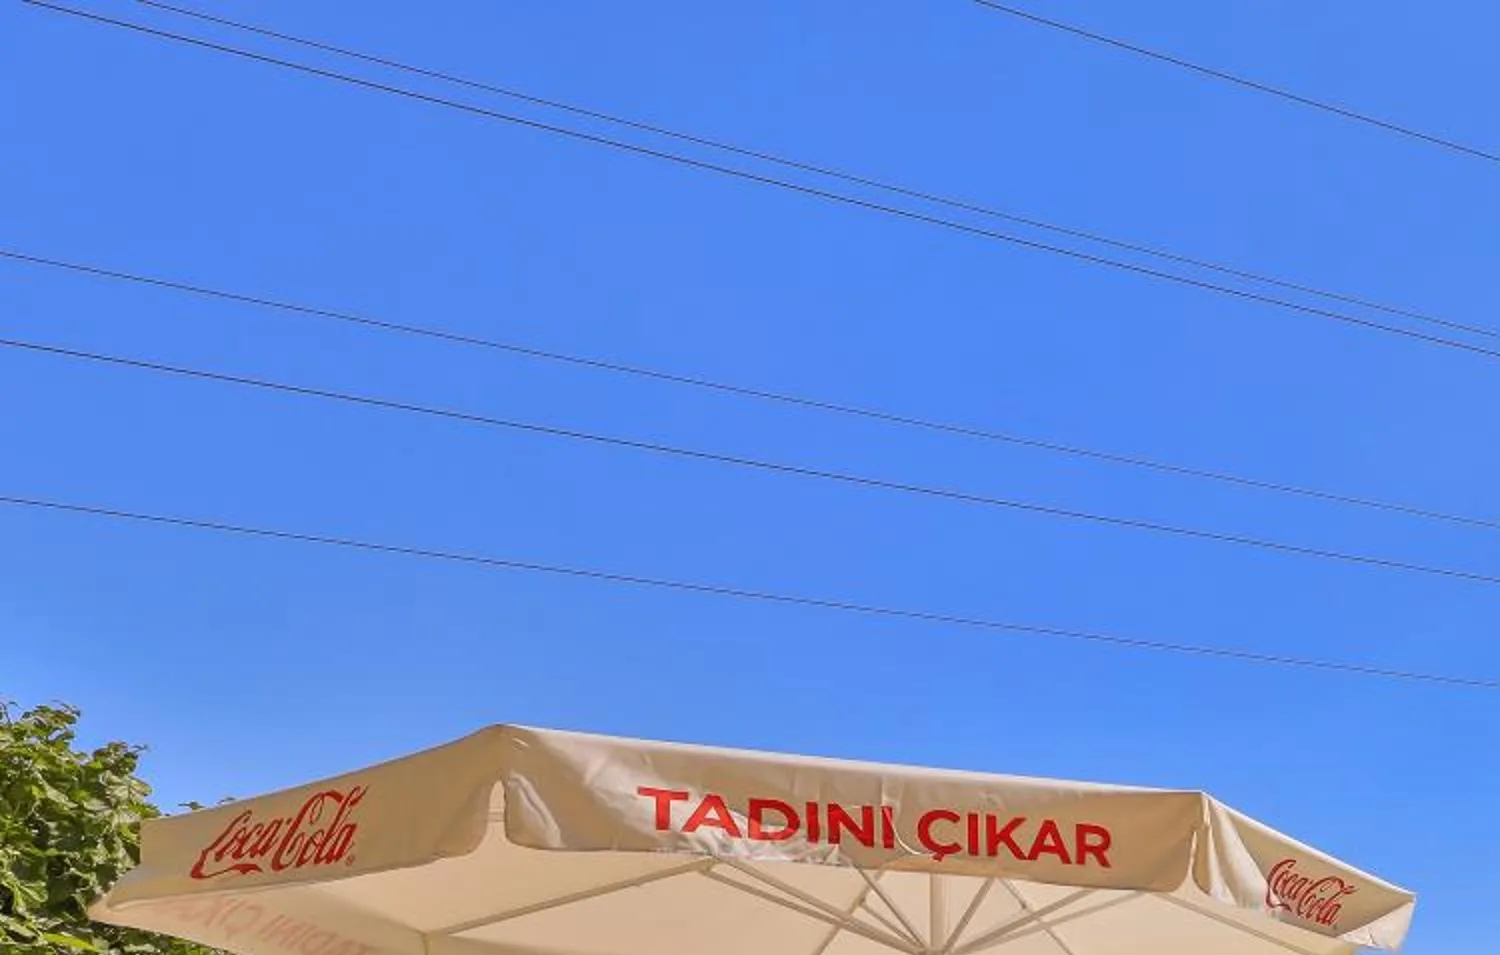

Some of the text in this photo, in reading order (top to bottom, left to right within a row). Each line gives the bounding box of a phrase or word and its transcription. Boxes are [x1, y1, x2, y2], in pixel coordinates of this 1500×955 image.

[190, 783, 368, 879] Coca-Cola
[638, 787, 1112, 868] TADINI ÇIKAR
[1265, 858, 1358, 926] Coca-Cola
